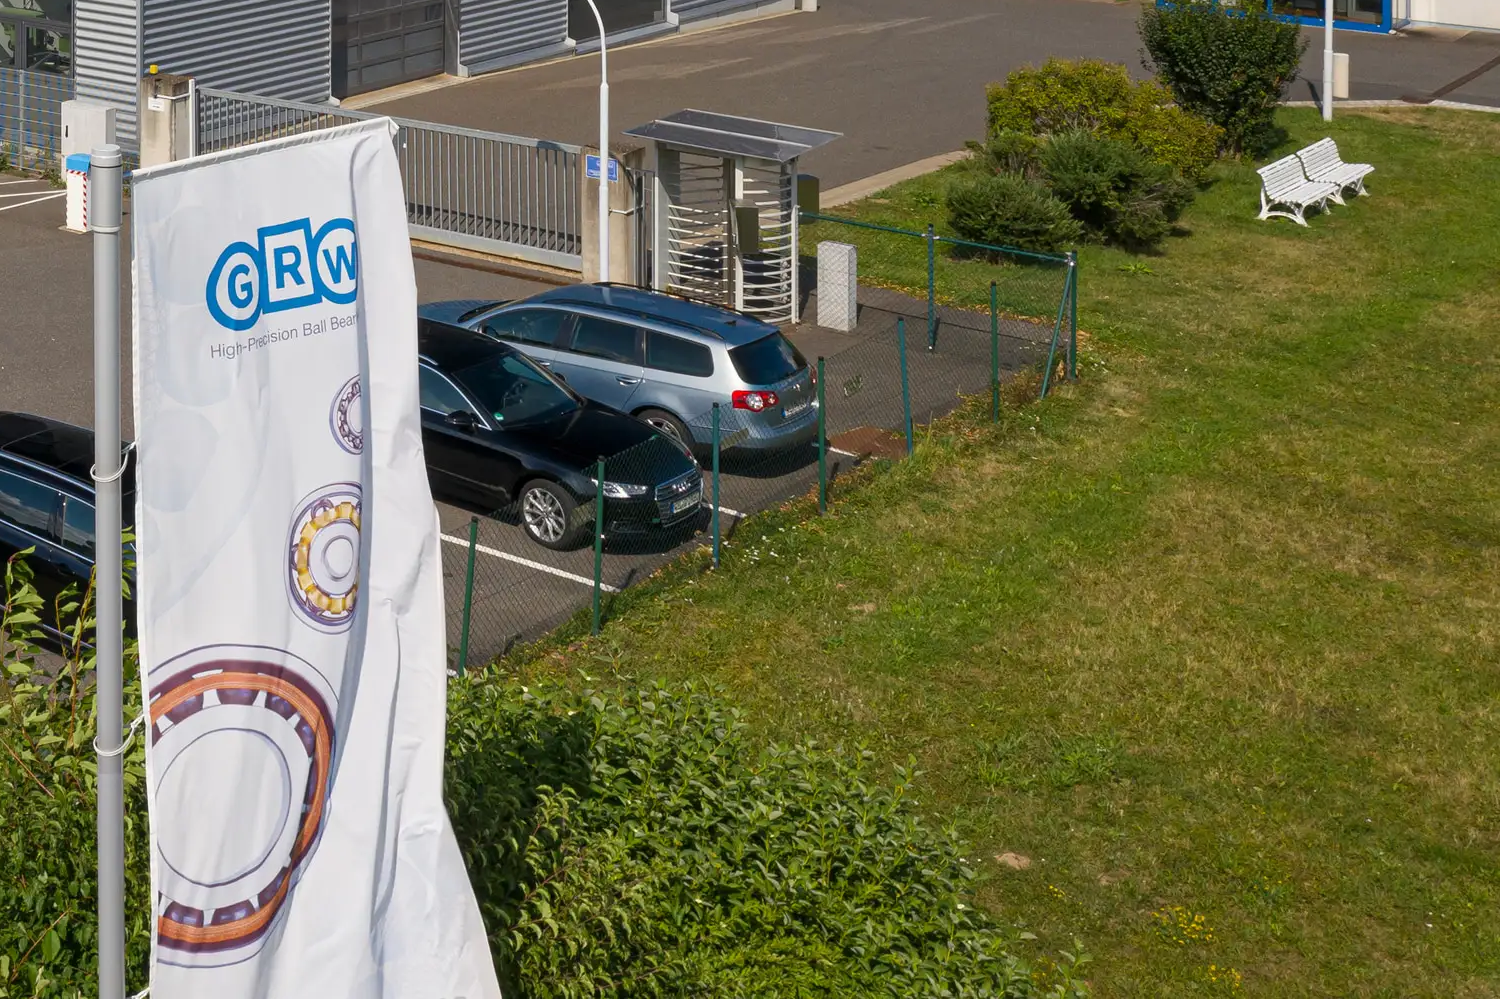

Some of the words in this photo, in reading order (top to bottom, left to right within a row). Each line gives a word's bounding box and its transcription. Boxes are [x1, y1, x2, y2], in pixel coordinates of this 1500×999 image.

[210, 327, 298, 360] High-Precision
[302, 319, 328, 338] Ball
[330, 313, 359, 331] Bear
